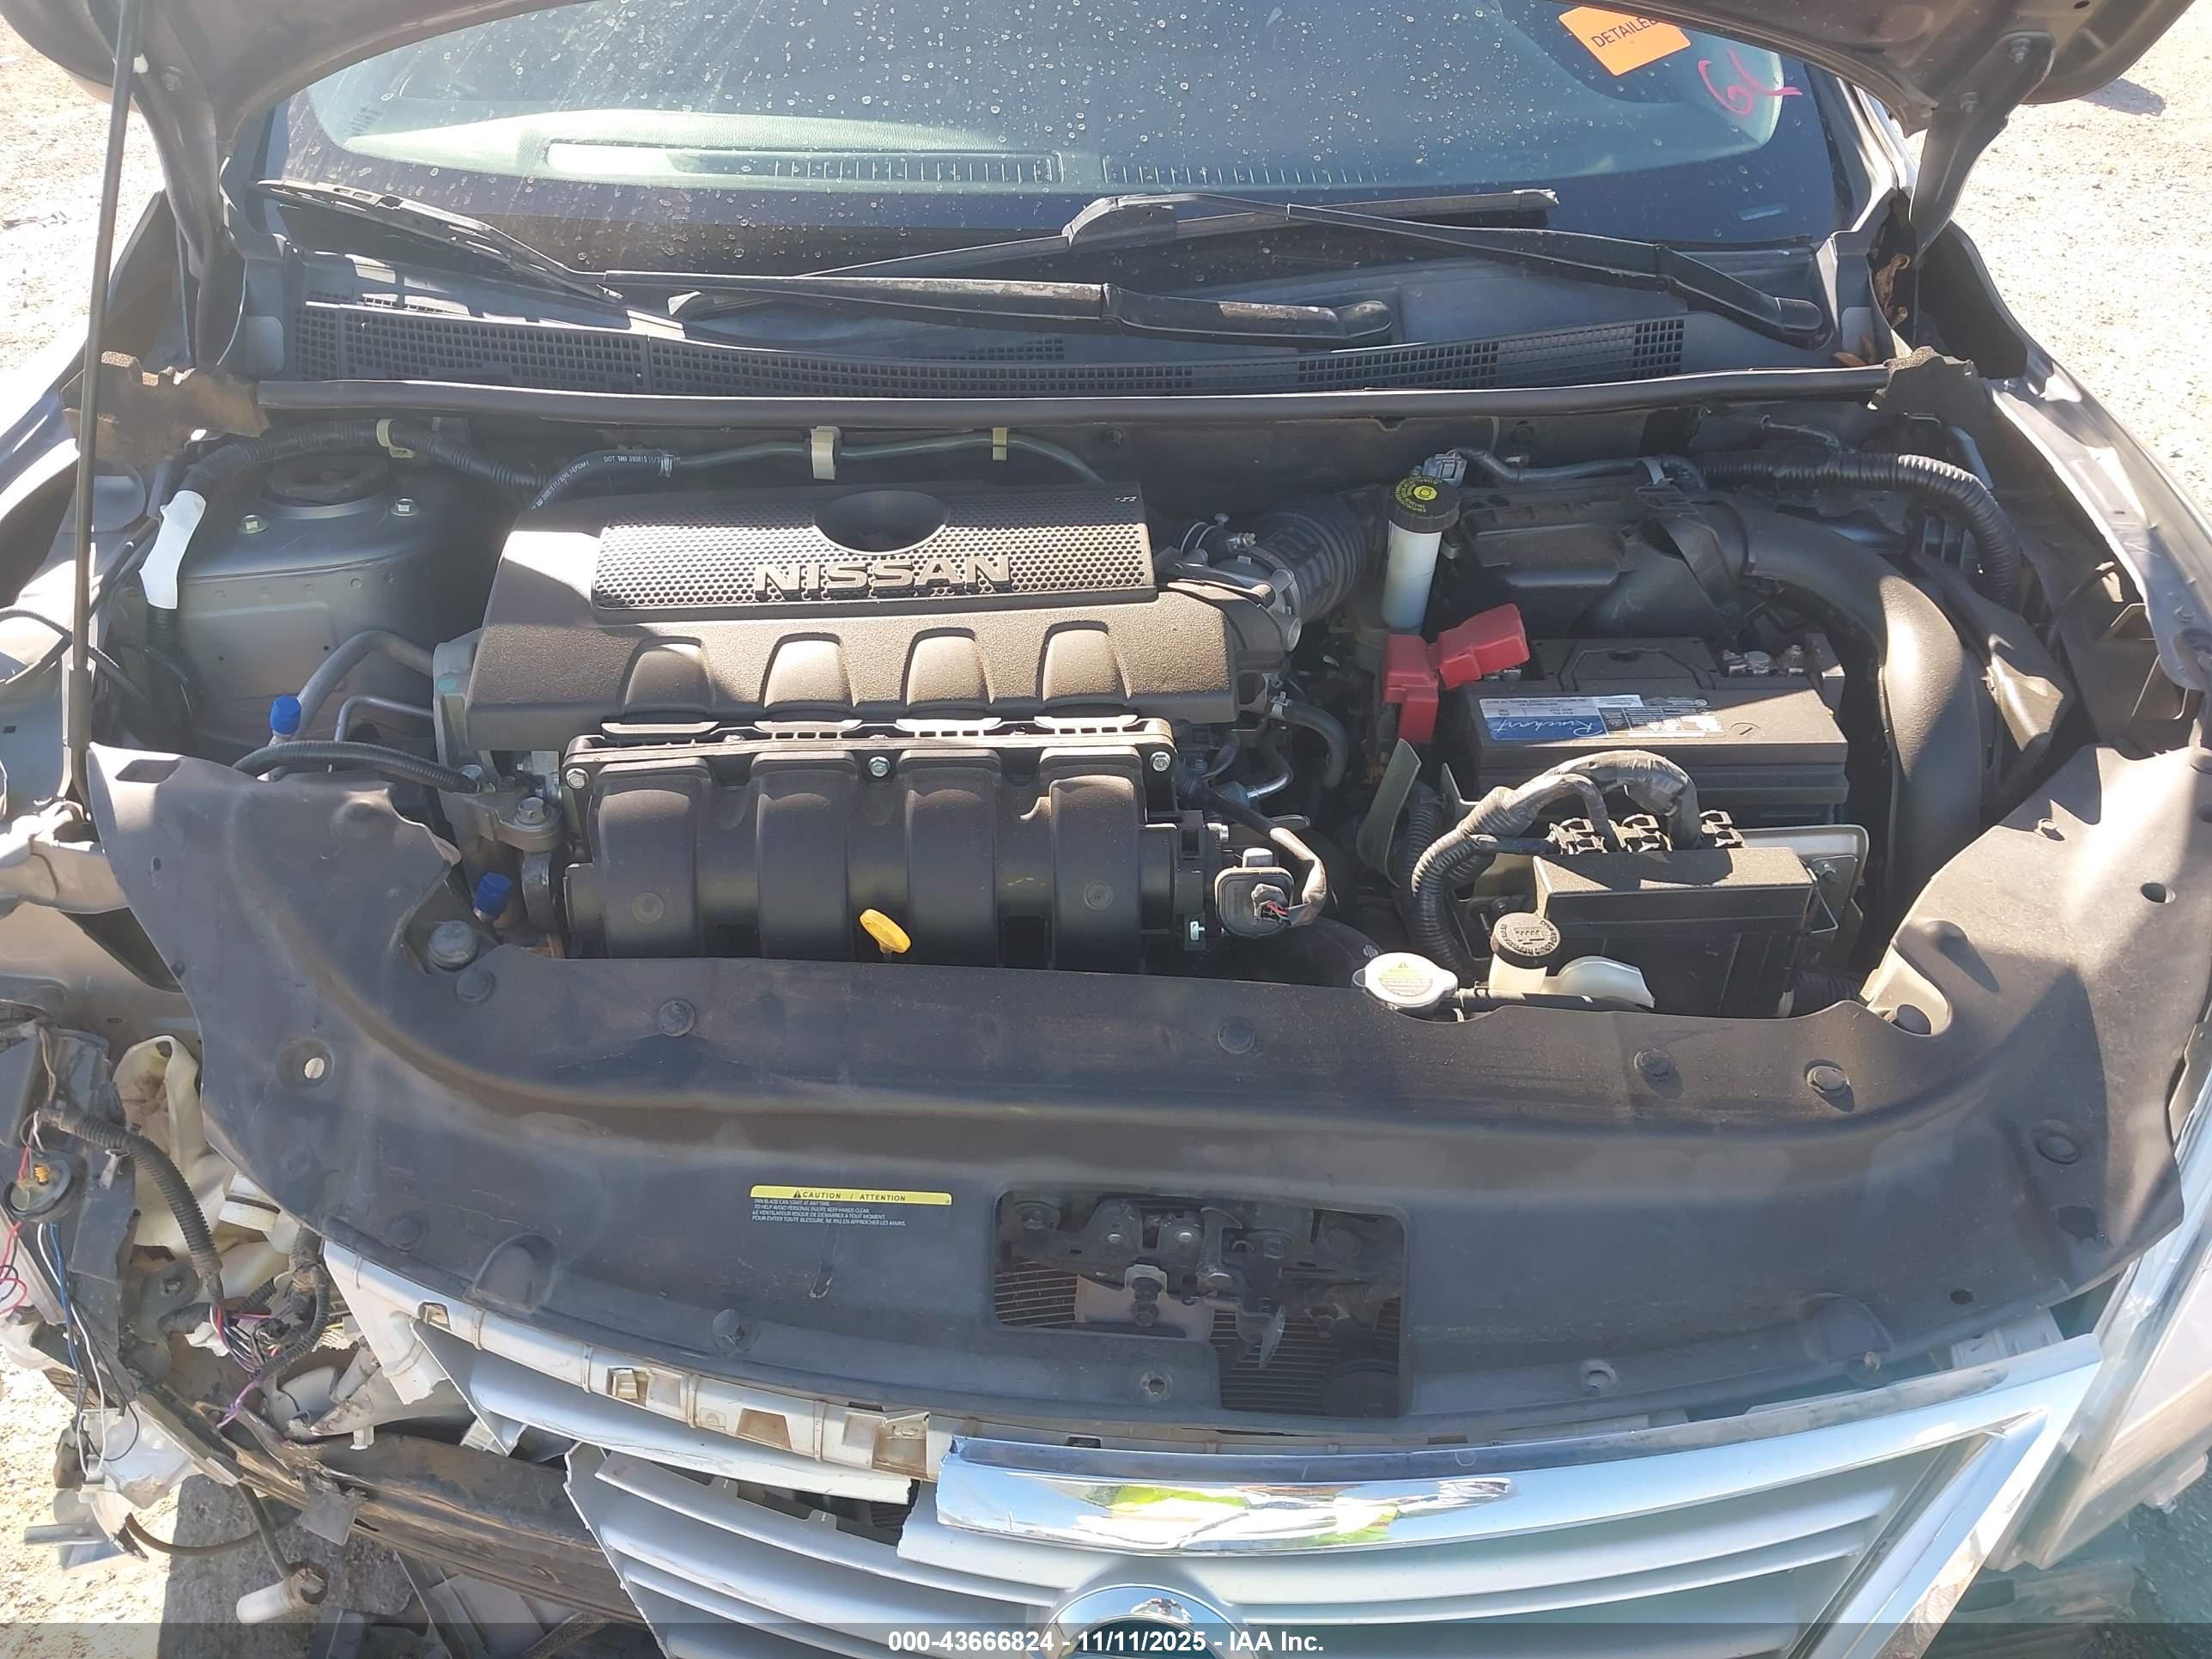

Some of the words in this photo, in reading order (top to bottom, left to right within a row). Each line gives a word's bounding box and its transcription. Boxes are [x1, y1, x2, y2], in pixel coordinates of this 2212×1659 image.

[755, 556, 1012, 592] NISSAN
[802, 1191, 841, 1200] CAUTION
[859, 1194, 906, 1202] ATTENTION
